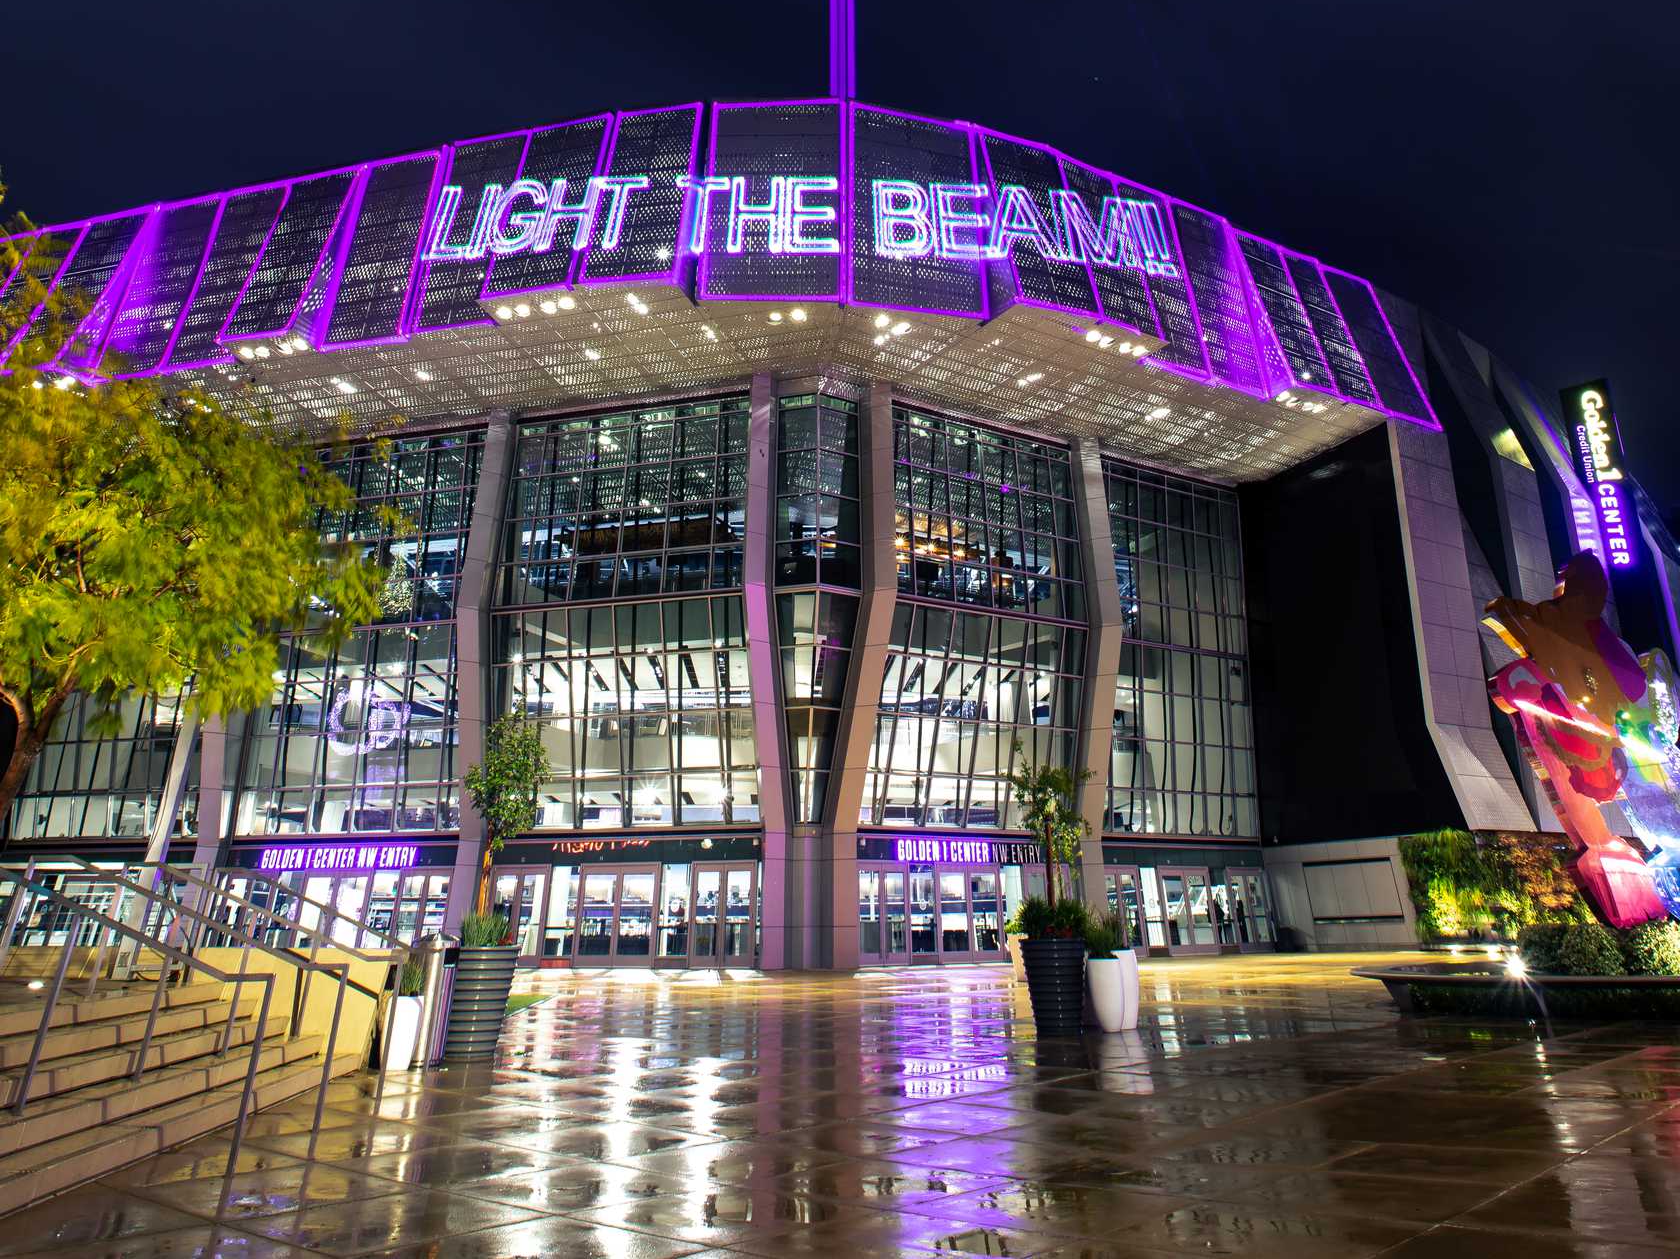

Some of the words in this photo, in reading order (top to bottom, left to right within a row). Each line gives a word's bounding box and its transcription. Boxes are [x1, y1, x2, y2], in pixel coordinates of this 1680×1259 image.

[421, 177, 649, 260] LIGHT
[676, 176, 840, 254] THE
[1576, 425, 1591, 454] Credit
[1581, 390, 1611, 468] Golden
[1582, 456, 1595, 483] Union
[1598, 483, 1631, 565] CENTER
[261, 849, 304, 869] GOLDEN
[313, 848, 356, 869] CENTER
[357, 847, 379, 868] NW
[379, 846, 417, 867] ENTRY
[897, 839, 940, 861] GOLDEN
[942, 841, 948, 862] 1
[950, 841, 989, 862] CENTER
[991, 843, 1008, 863] NW
[1011, 844, 1041, 863] ENTRY
